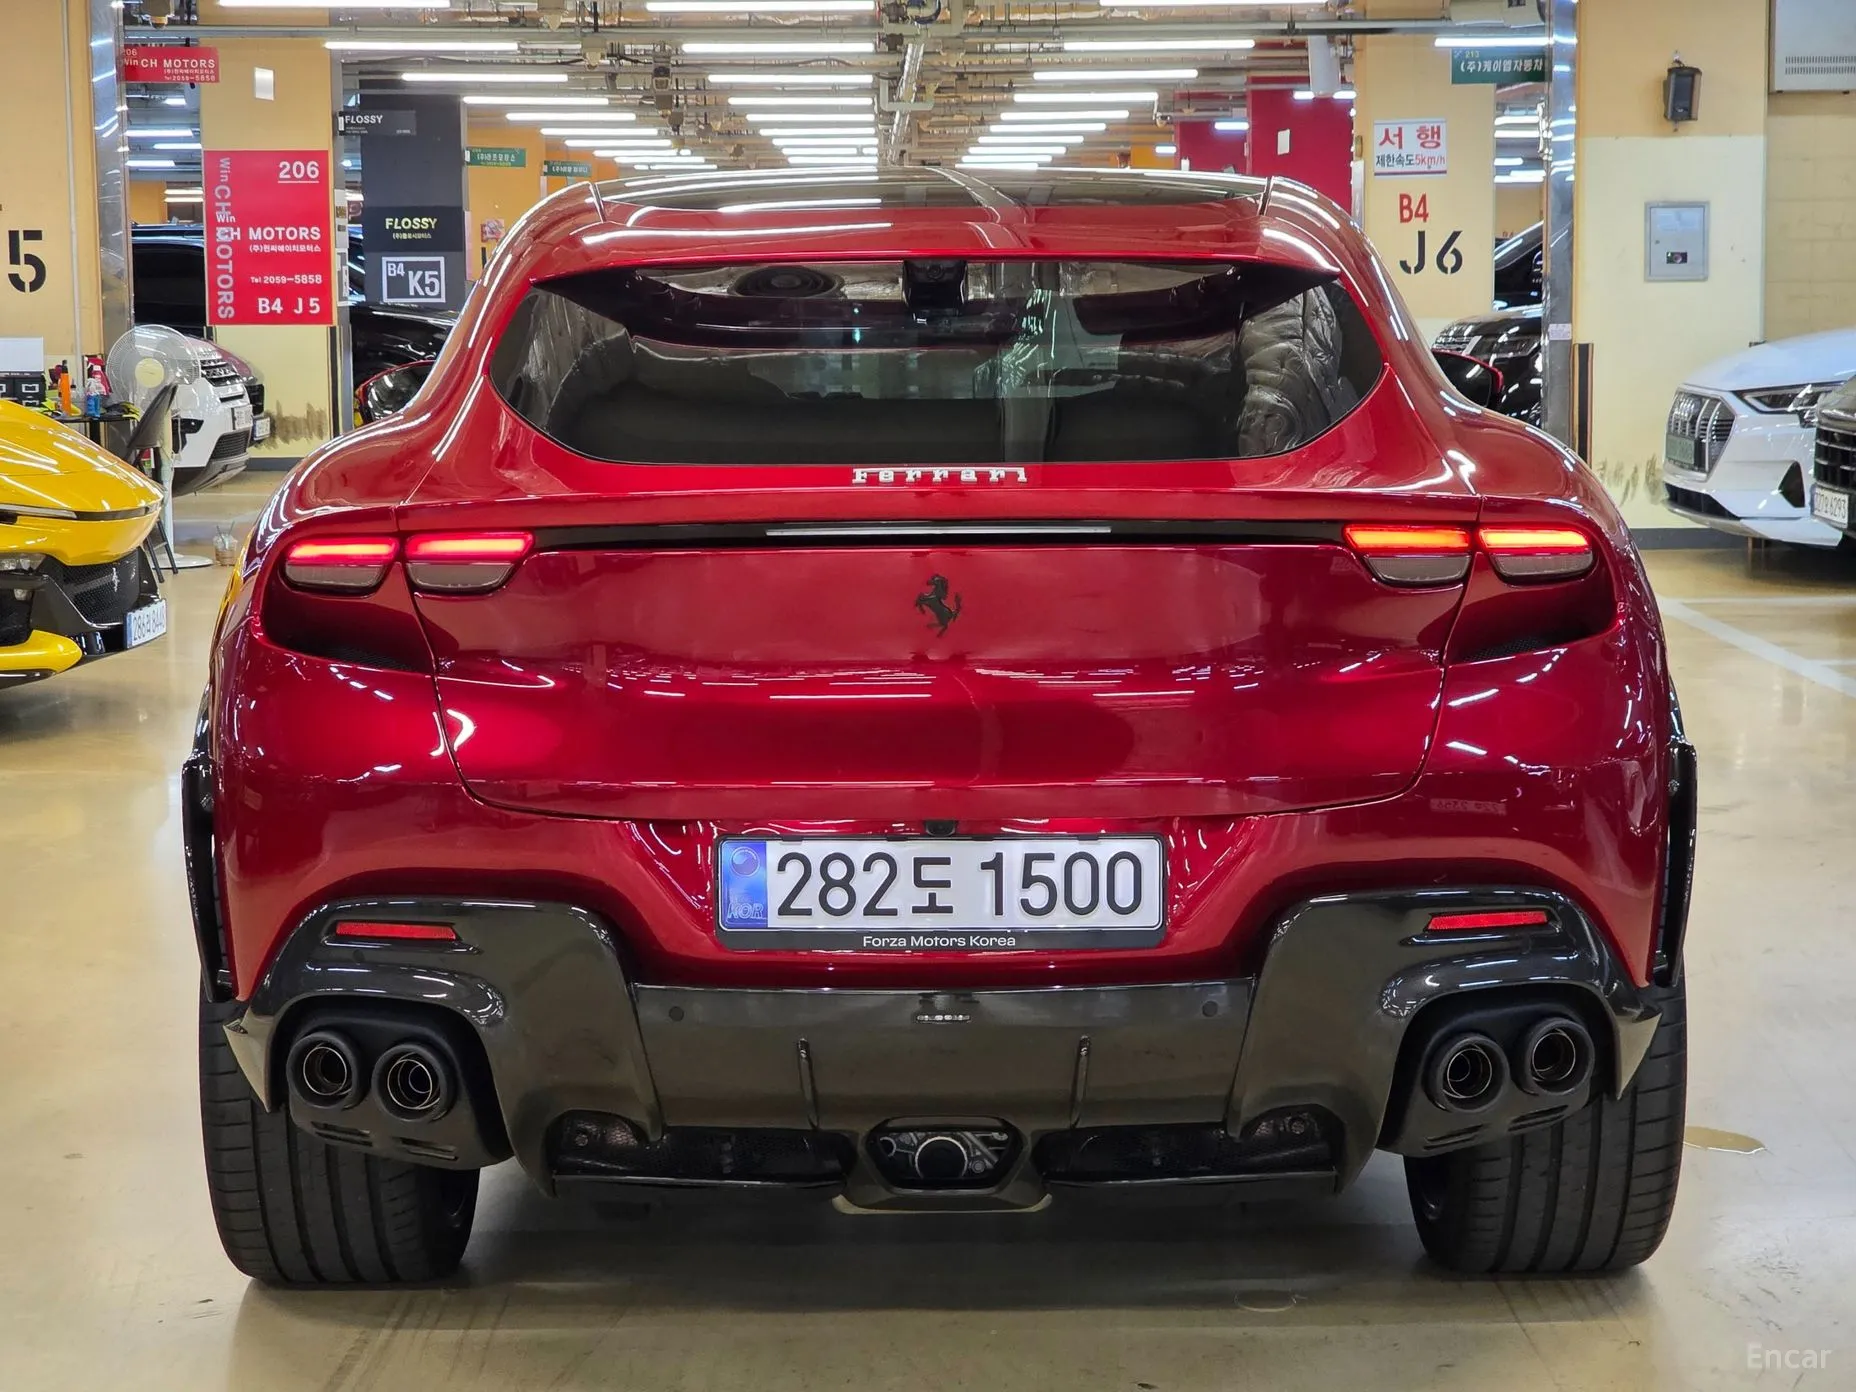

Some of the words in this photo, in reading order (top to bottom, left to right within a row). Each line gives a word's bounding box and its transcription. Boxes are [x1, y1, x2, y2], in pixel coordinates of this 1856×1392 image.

[163, 59, 216, 68] MOTORS
[345, 114, 383, 124] FLOSSY
[278, 160, 320, 179] 206
[1399, 192, 1429, 223] B4
[385, 217, 437, 230] FLOSSY
[249, 226, 321, 241] MOTORS
[8, 229, 47, 293] 5
[263, 274, 322, 284] 2059-5858
[387, 262, 405, 277] B4
[408, 270, 440, 296] K5
[257, 297, 283, 314] B4
[852, 467, 1027, 484] Ferrari
[777, 851, 954, 917] 282도
[980, 851, 1143, 917] 1500
[727, 902, 765, 918] KOR
[863, 936, 907, 947] Forza
[910, 936, 966, 947] Motors
[969, 936, 1016, 947] Korea
